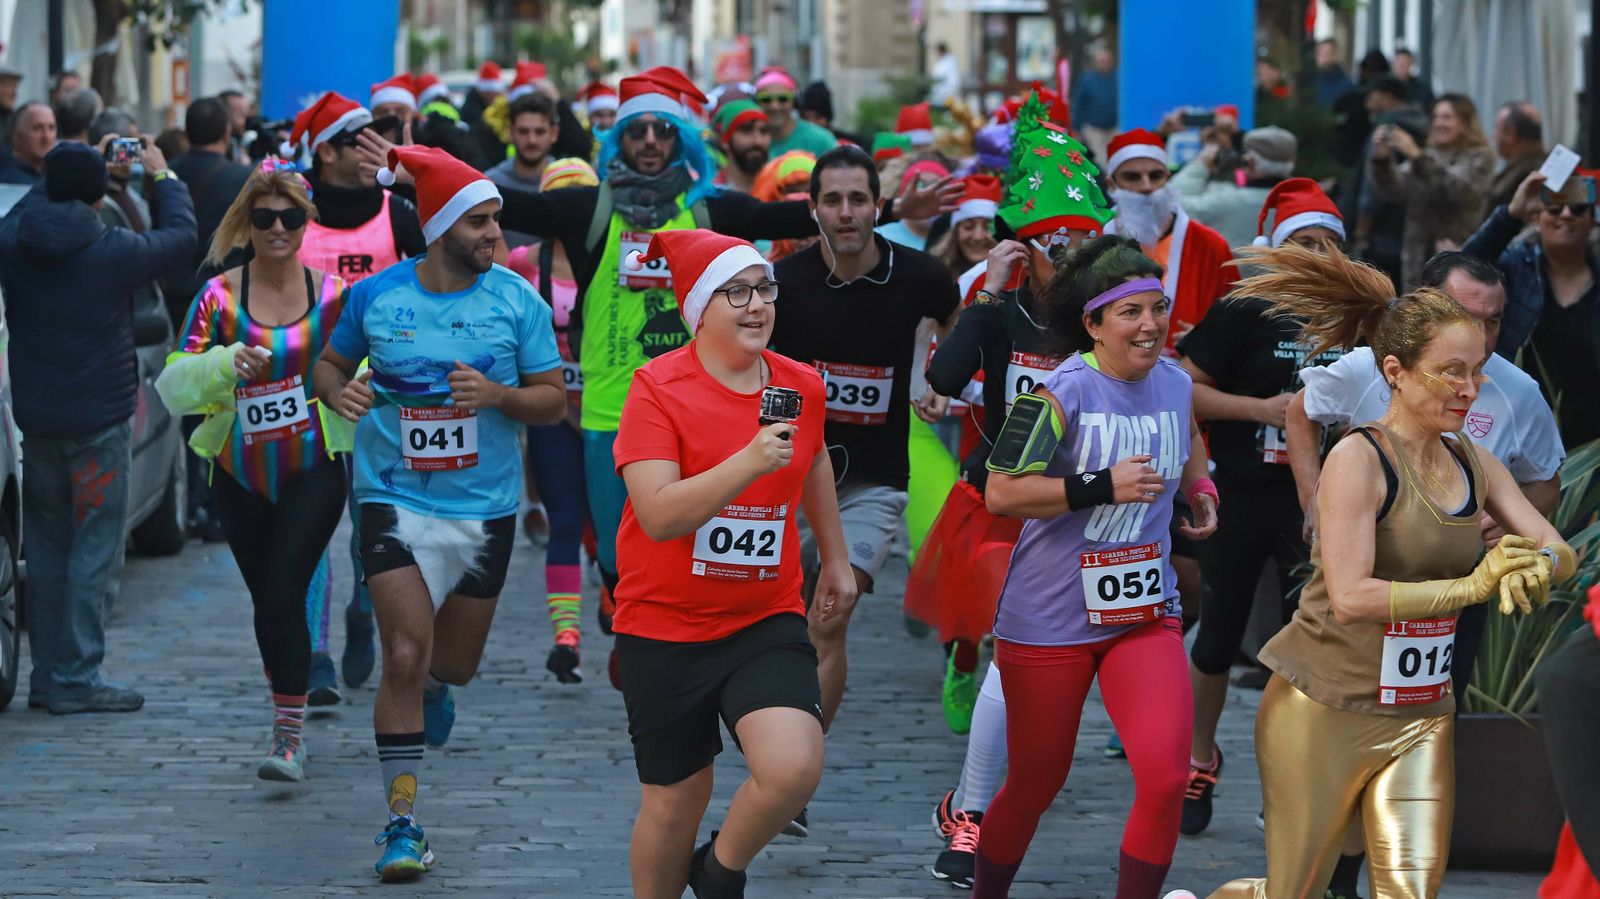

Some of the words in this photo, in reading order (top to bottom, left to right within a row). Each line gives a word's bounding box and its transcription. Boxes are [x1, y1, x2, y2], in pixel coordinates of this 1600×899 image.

[338, 254, 373, 273] FER
[643, 332, 686, 347] STAFF
[1011, 351, 1024, 364] II
[1274, 350, 1294, 358] VILLA
[826, 381, 880, 407] 039
[247, 396, 298, 426] 053
[401, 407, 413, 419] II
[409, 425, 464, 451] 041
[1076, 411, 1182, 480] TYPICAL
[708, 526, 776, 557] 042
[1082, 553, 1101, 567] II
[1101, 551, 1128, 559] CARRERA
[1128, 546, 1151, 556] POPULAR
[1120, 553, 1146, 562] SILVESTRE
[1097, 568, 1162, 602] 052
[1387, 621, 1409, 635] II
[1397, 642, 1453, 678] 012
